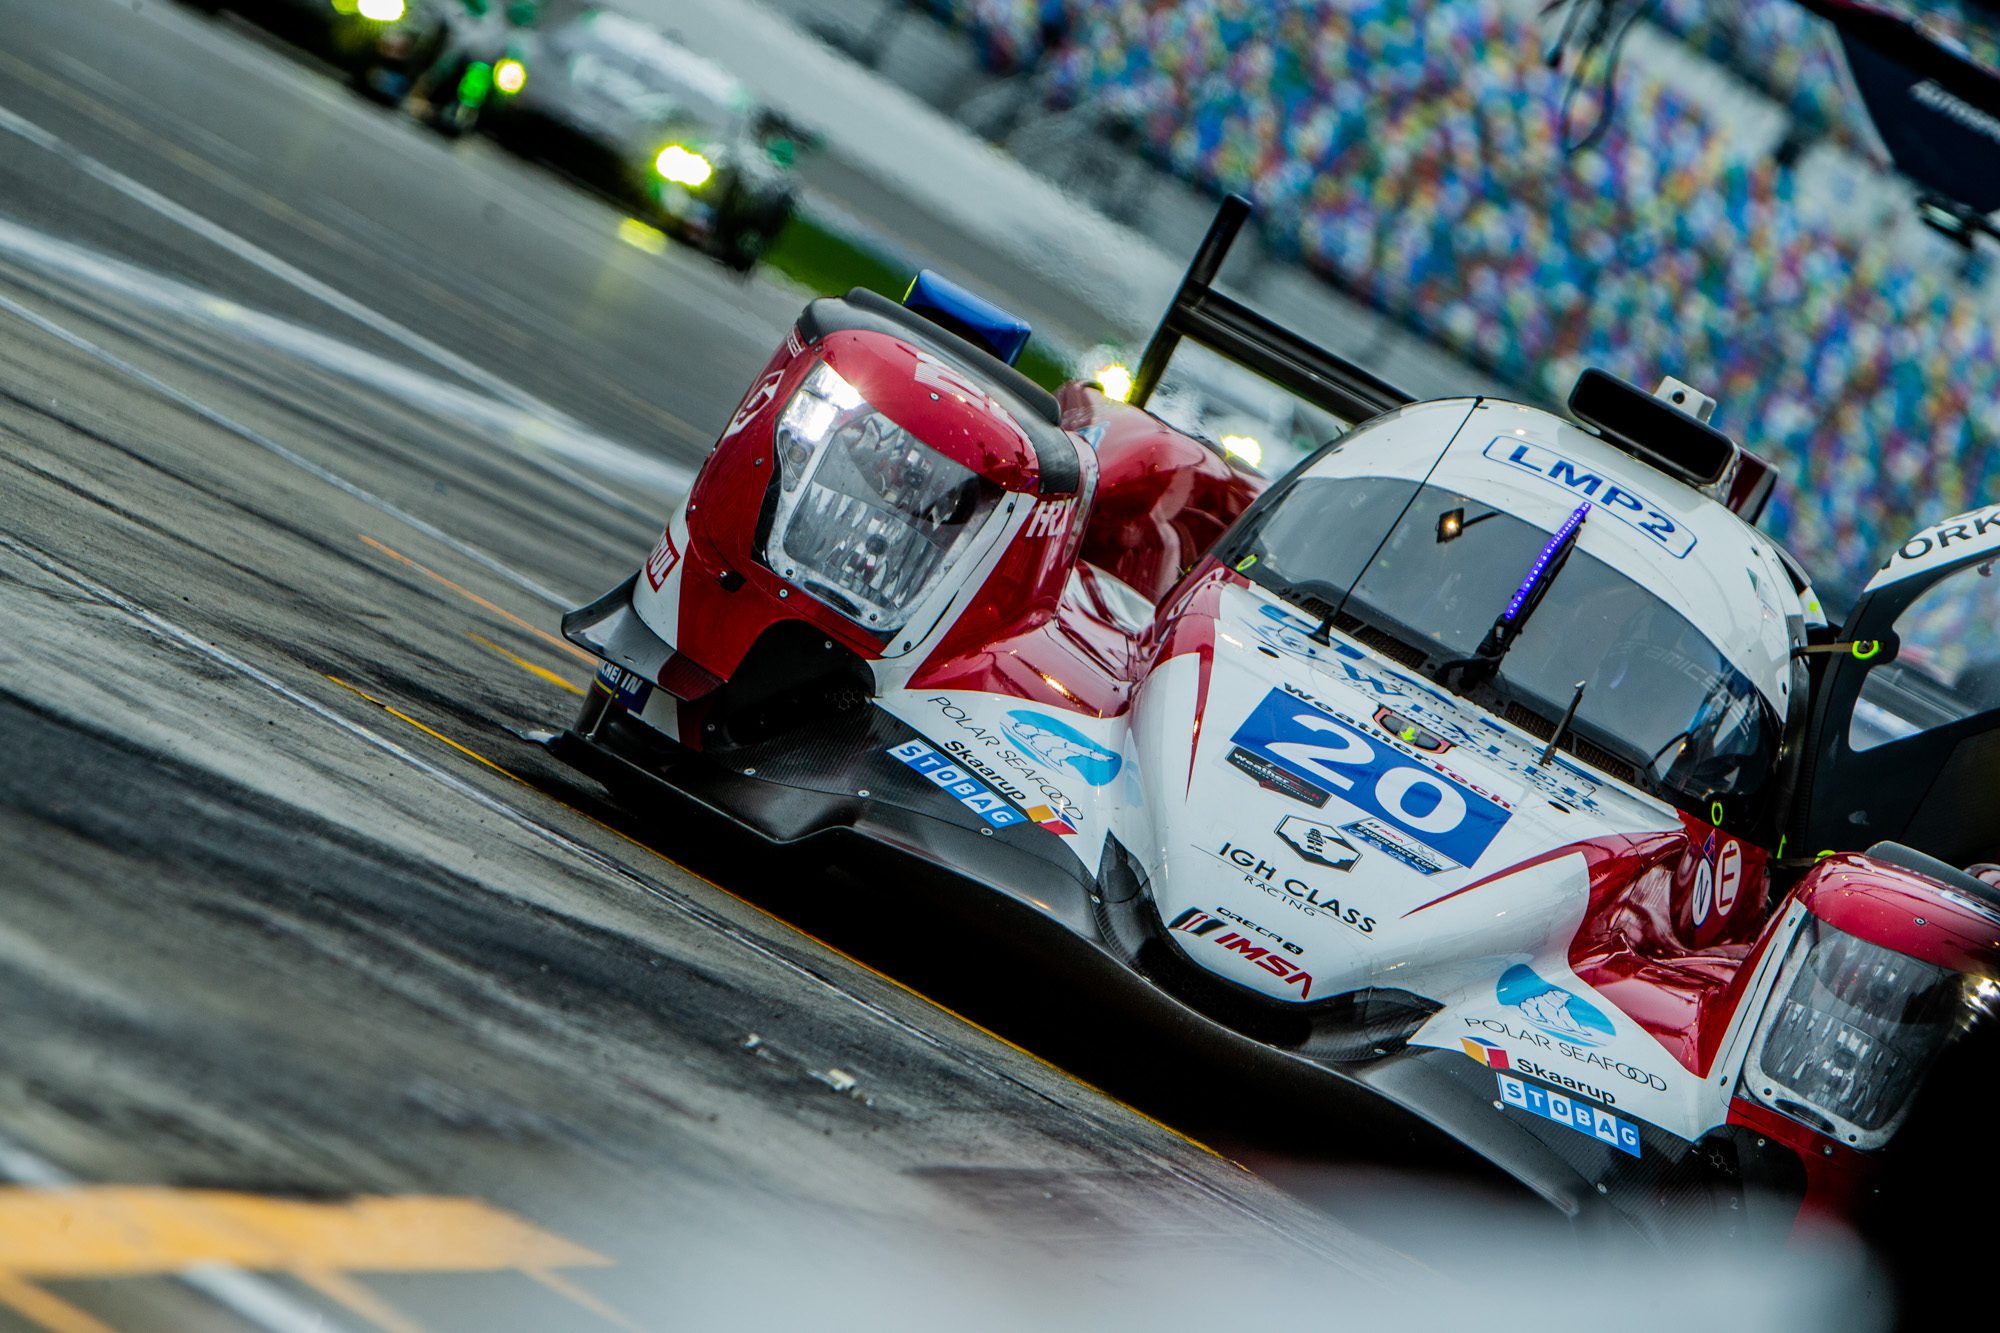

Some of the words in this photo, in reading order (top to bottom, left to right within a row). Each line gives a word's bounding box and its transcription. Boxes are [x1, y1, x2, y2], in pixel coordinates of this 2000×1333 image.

[1508, 444, 1676, 543] LMP2
[926, 695, 1001, 748] POLAR
[995, 747, 1084, 821] SEAFOOD
[944, 740, 1026, 801] Skaarup
[1264, 713, 1467, 834] 20
[1283, 681, 1512, 810] WeatherTech
[899, 744, 1014, 825] STOBAG
[1215, 906, 1284, 943] ORECA
[1244, 873, 1315, 917] RACING
[1284, 878, 1377, 933] CLASS
[1213, 931, 1313, 1001] IMSA
[1464, 1017, 1552, 1052] POLAR
[1558, 1041, 1668, 1092] SEAFOOD
[1516, 1056, 1616, 1105] Skaarup
[1505, 1081, 1637, 1146] STOBAG
